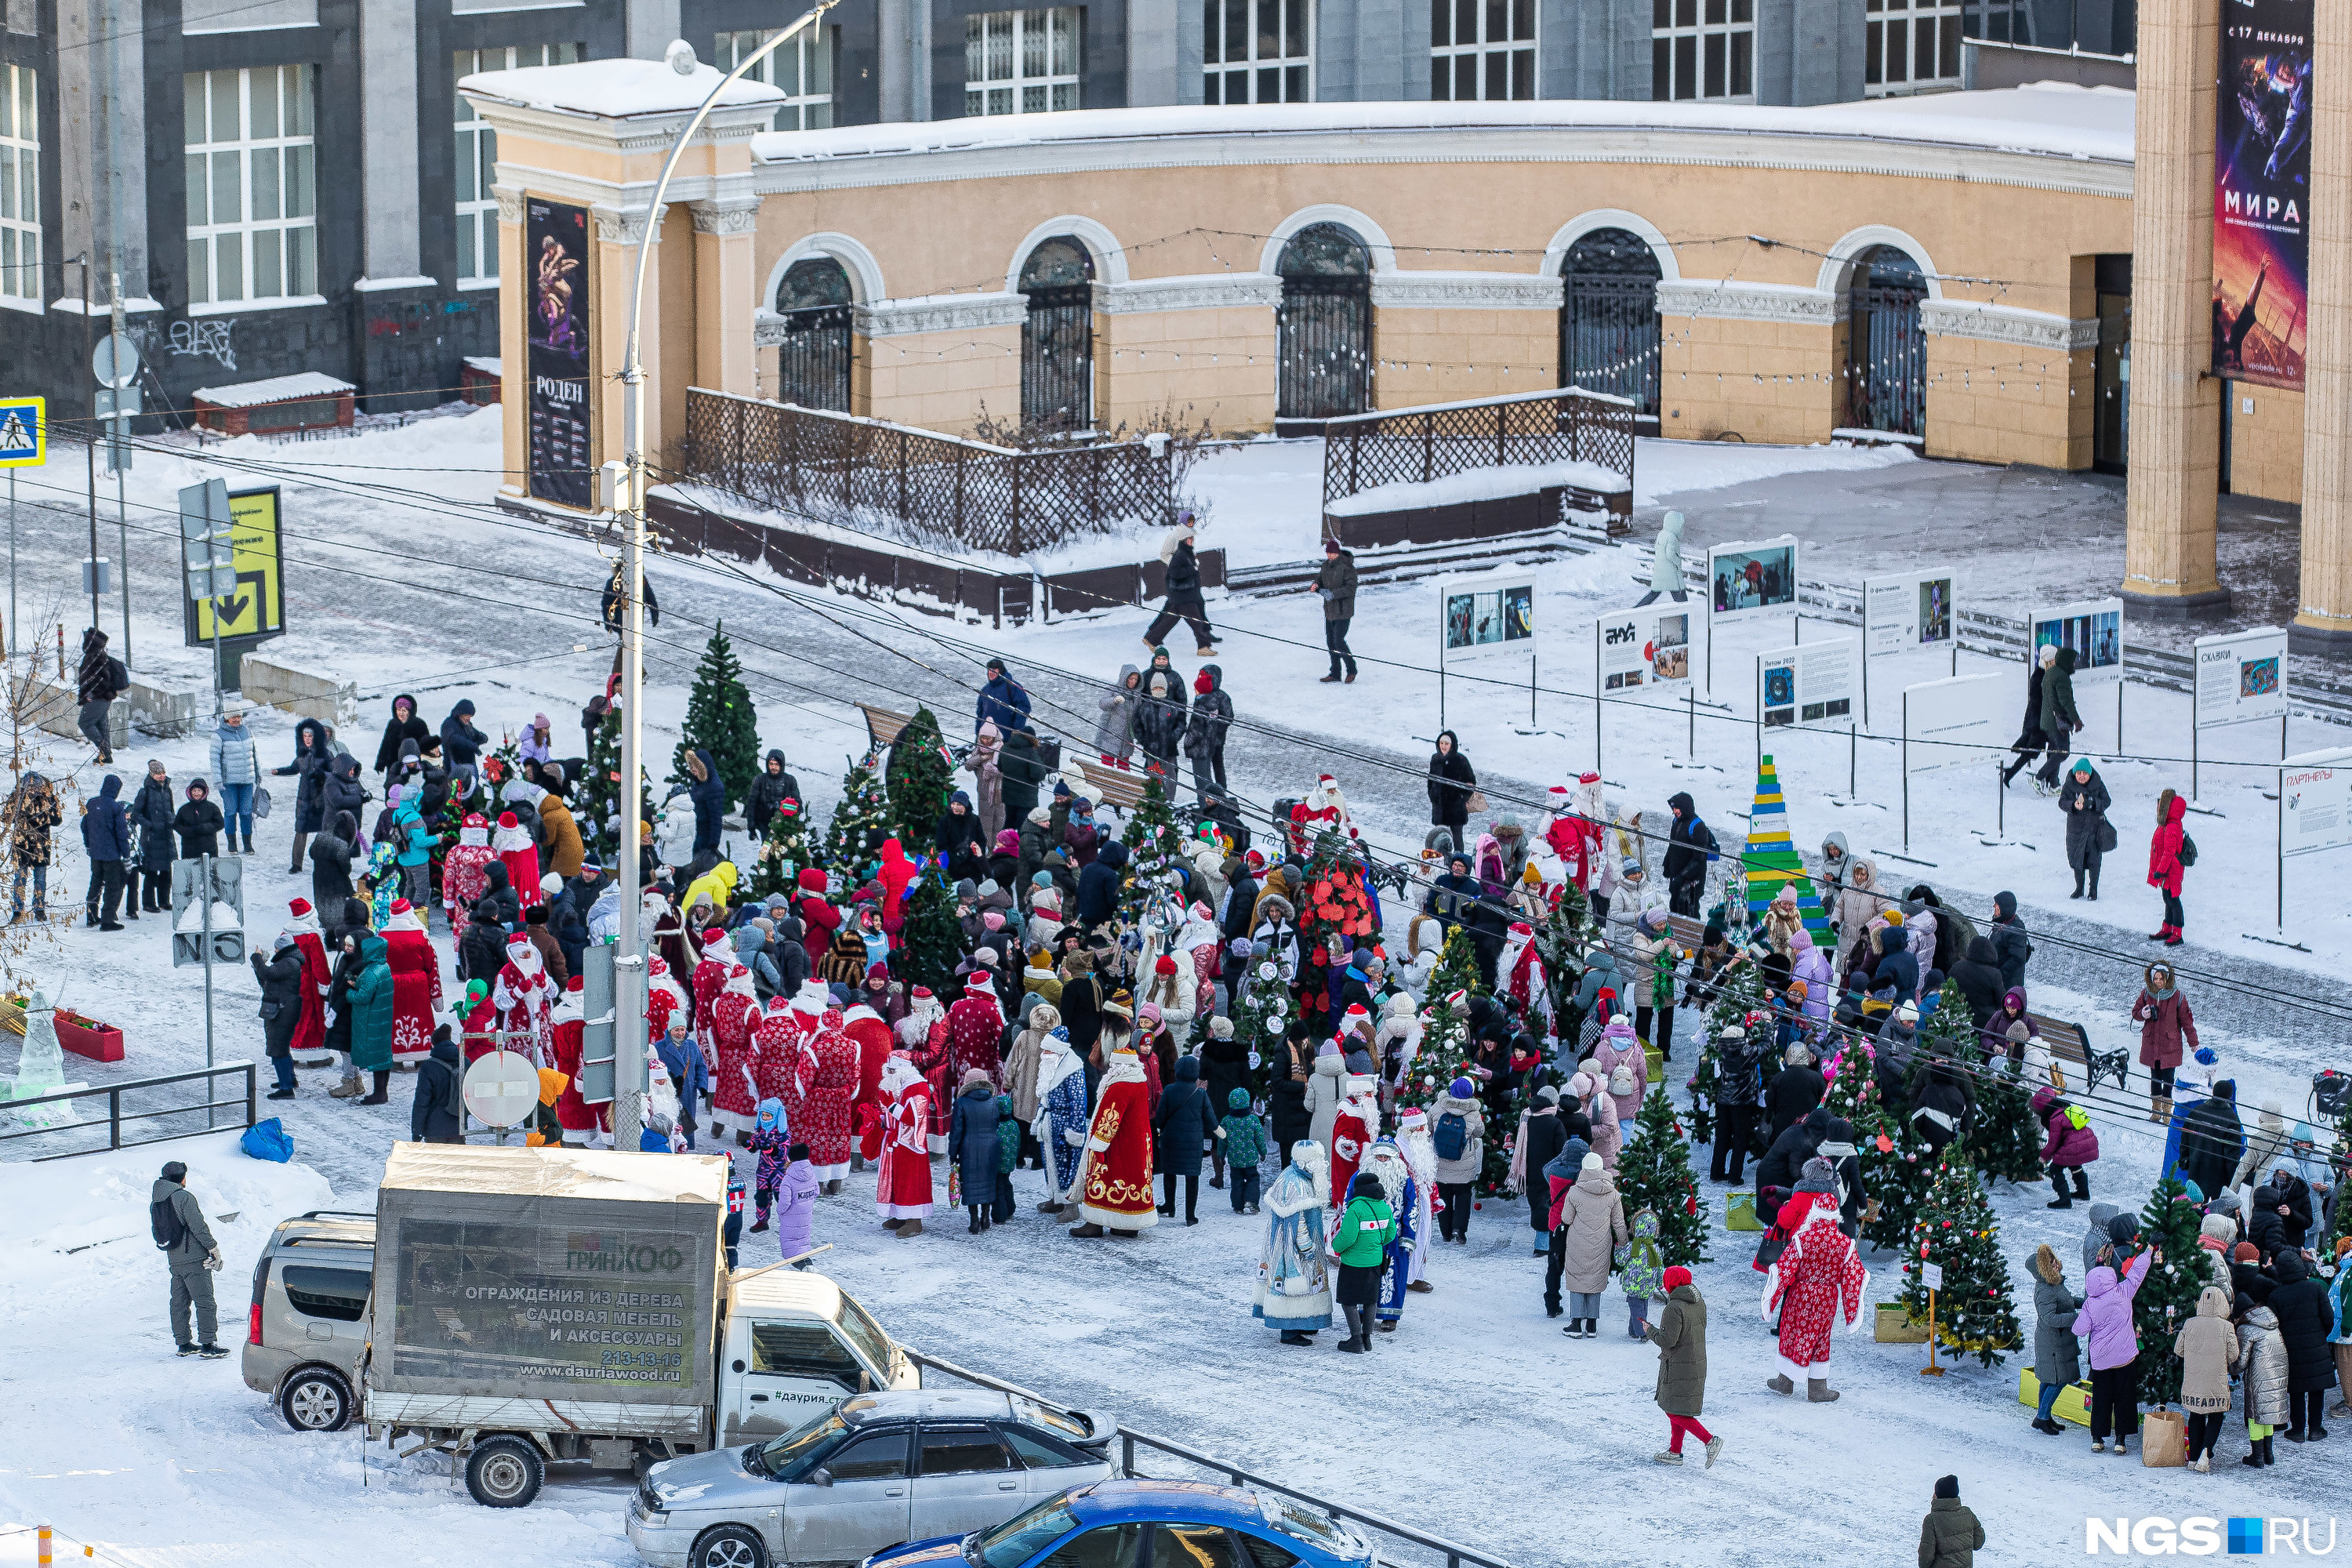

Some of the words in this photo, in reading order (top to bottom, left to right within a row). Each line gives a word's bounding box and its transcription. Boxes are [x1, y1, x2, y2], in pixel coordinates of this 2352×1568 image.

[2238, 25, 2252, 38] 17
[2256, 31, 2303, 45] ДЕКАБРЯ
[2225, 189, 2300, 223] МИРА
[536, 375, 583, 404] РОДЕН
[2201, 649, 2230, 663] СКАЗКИ
[2286, 768, 2332, 788] ПАРТНЕРЫ
[465, 1287, 584, 1303] ОГРАЖДЕНИЯ
[590, 1290, 612, 1305] ИЗ
[616, 1292, 684, 1308] ДЕРЕВА
[525, 1308, 608, 1324] САДОВАЯ
[612, 1312, 683, 1327] МЕБЕЛЬ
[550, 1328, 562, 1341] И
[566, 1329, 683, 1347] АКСЕССУАРЫ
[601, 1350, 682, 1367] 213-13-16
[520, 1365, 681, 1381] www.dauriawood.ru
